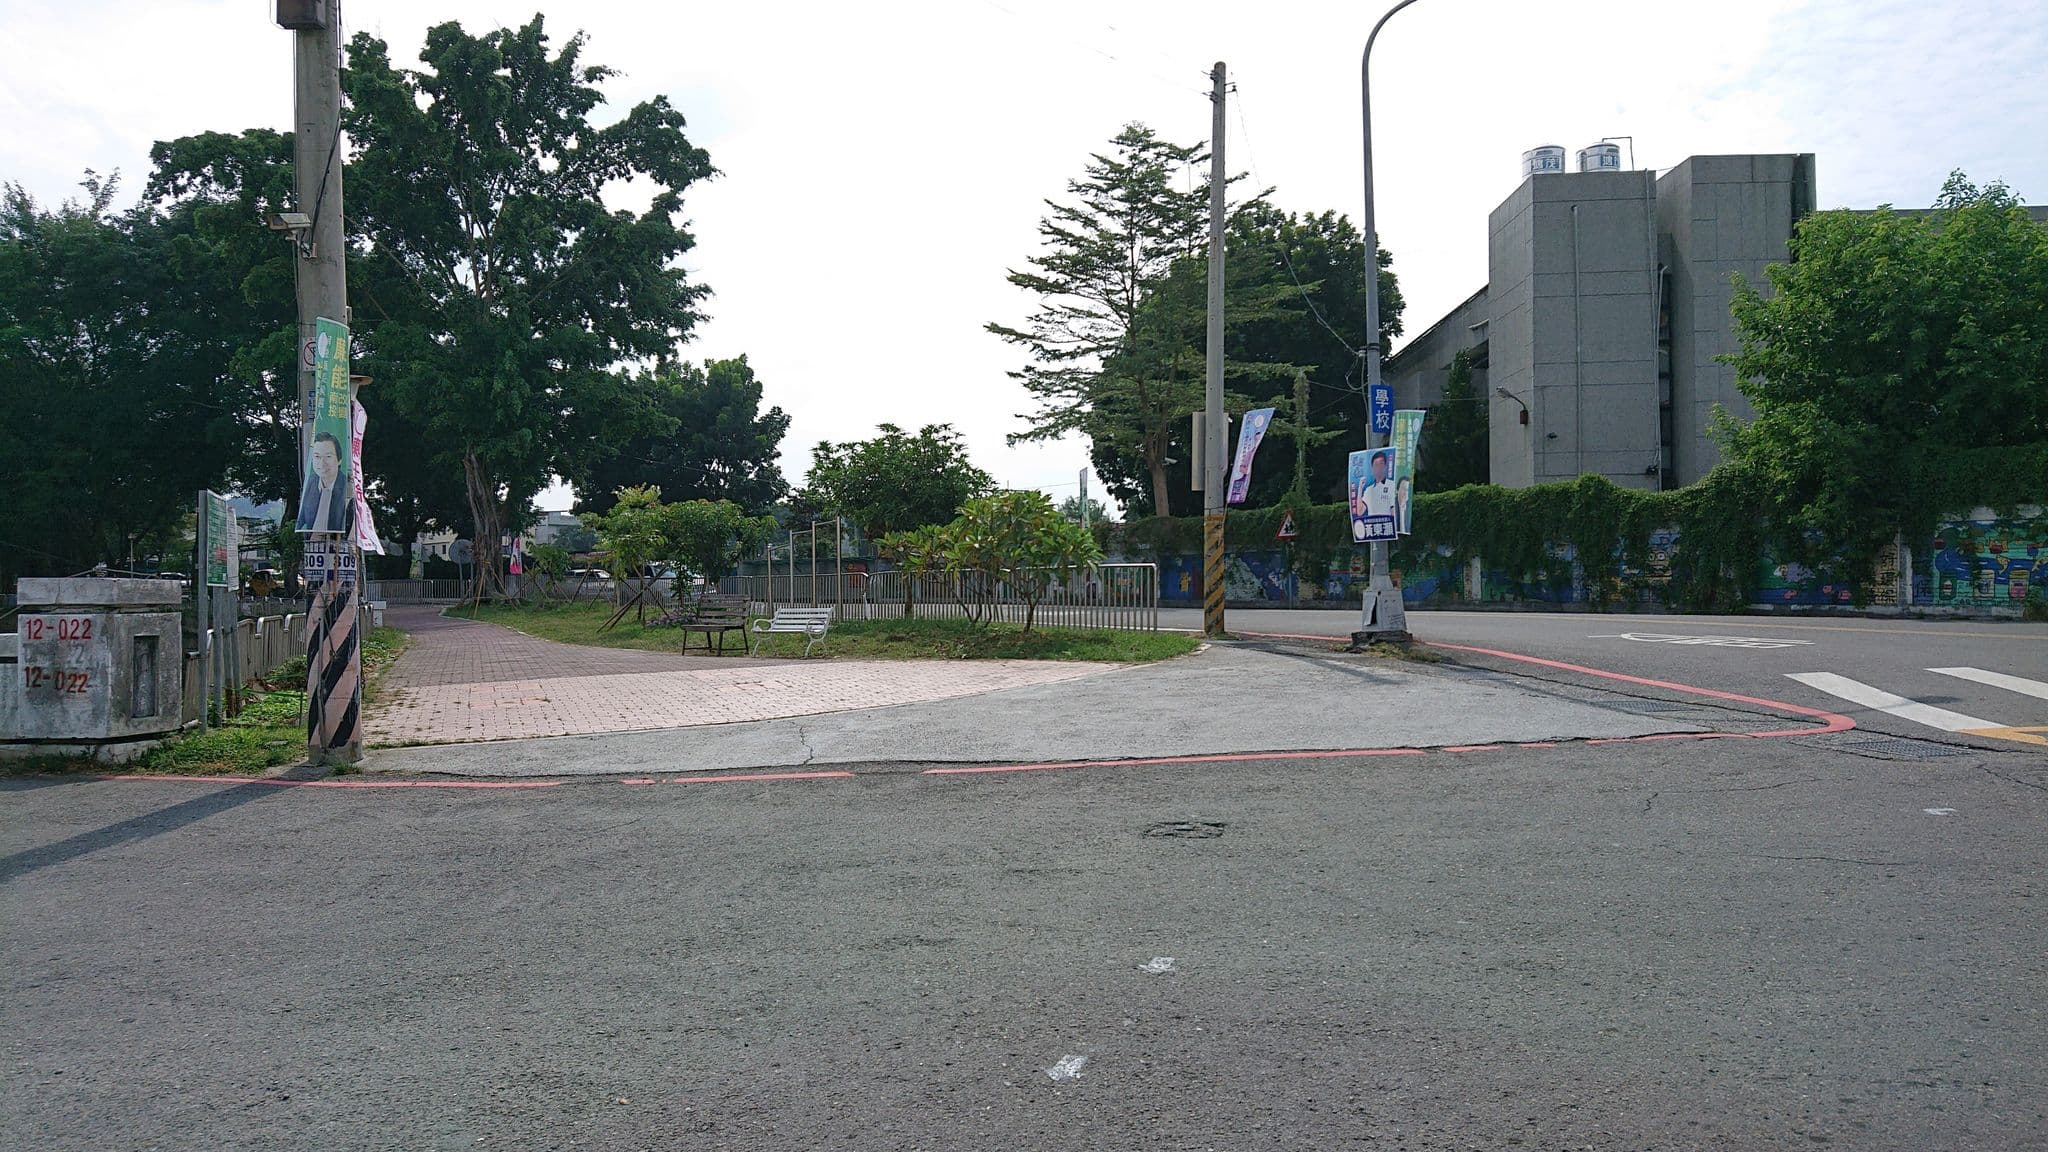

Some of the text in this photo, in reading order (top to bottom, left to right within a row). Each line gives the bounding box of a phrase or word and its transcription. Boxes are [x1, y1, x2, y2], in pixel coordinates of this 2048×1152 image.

[1375, 389, 1390, 429] 學校
[26, 619, 92, 640] 12-022
[24, 666, 88, 693] 12-022
